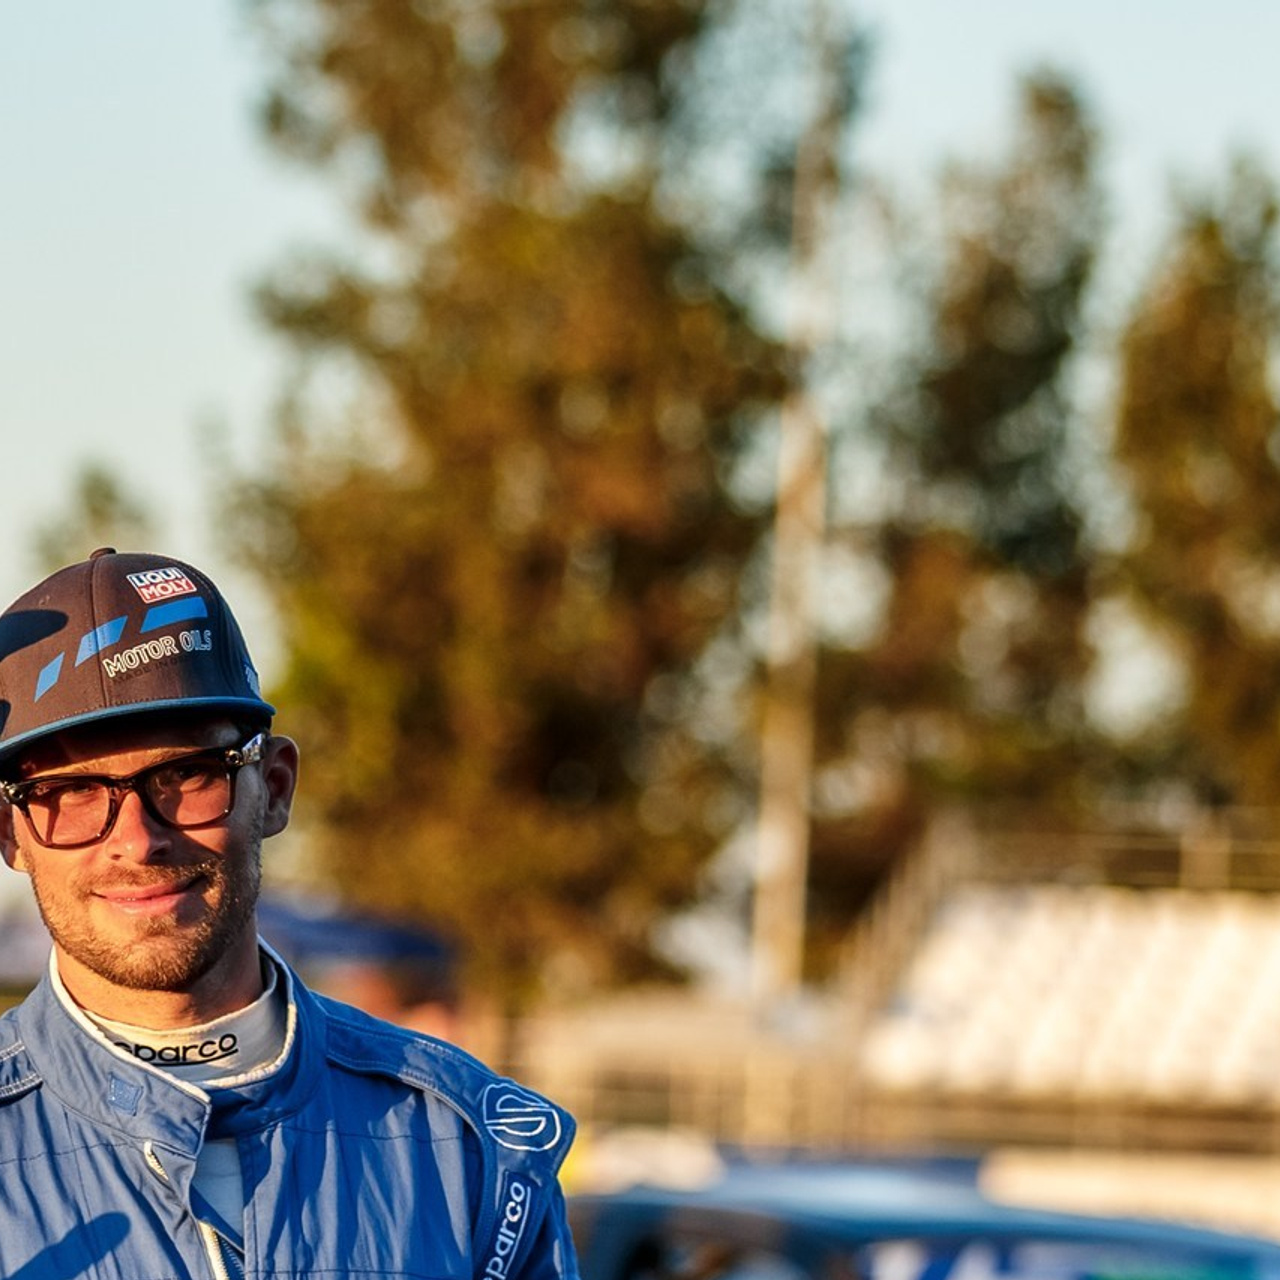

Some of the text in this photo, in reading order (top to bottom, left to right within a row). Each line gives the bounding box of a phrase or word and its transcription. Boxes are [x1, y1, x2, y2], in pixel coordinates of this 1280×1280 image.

[131, 567, 183, 587] LIQUI
[140, 579, 191, 600] MOLY
[102, 635, 179, 678] MOTOR
[179, 629, 213, 652] OILS
